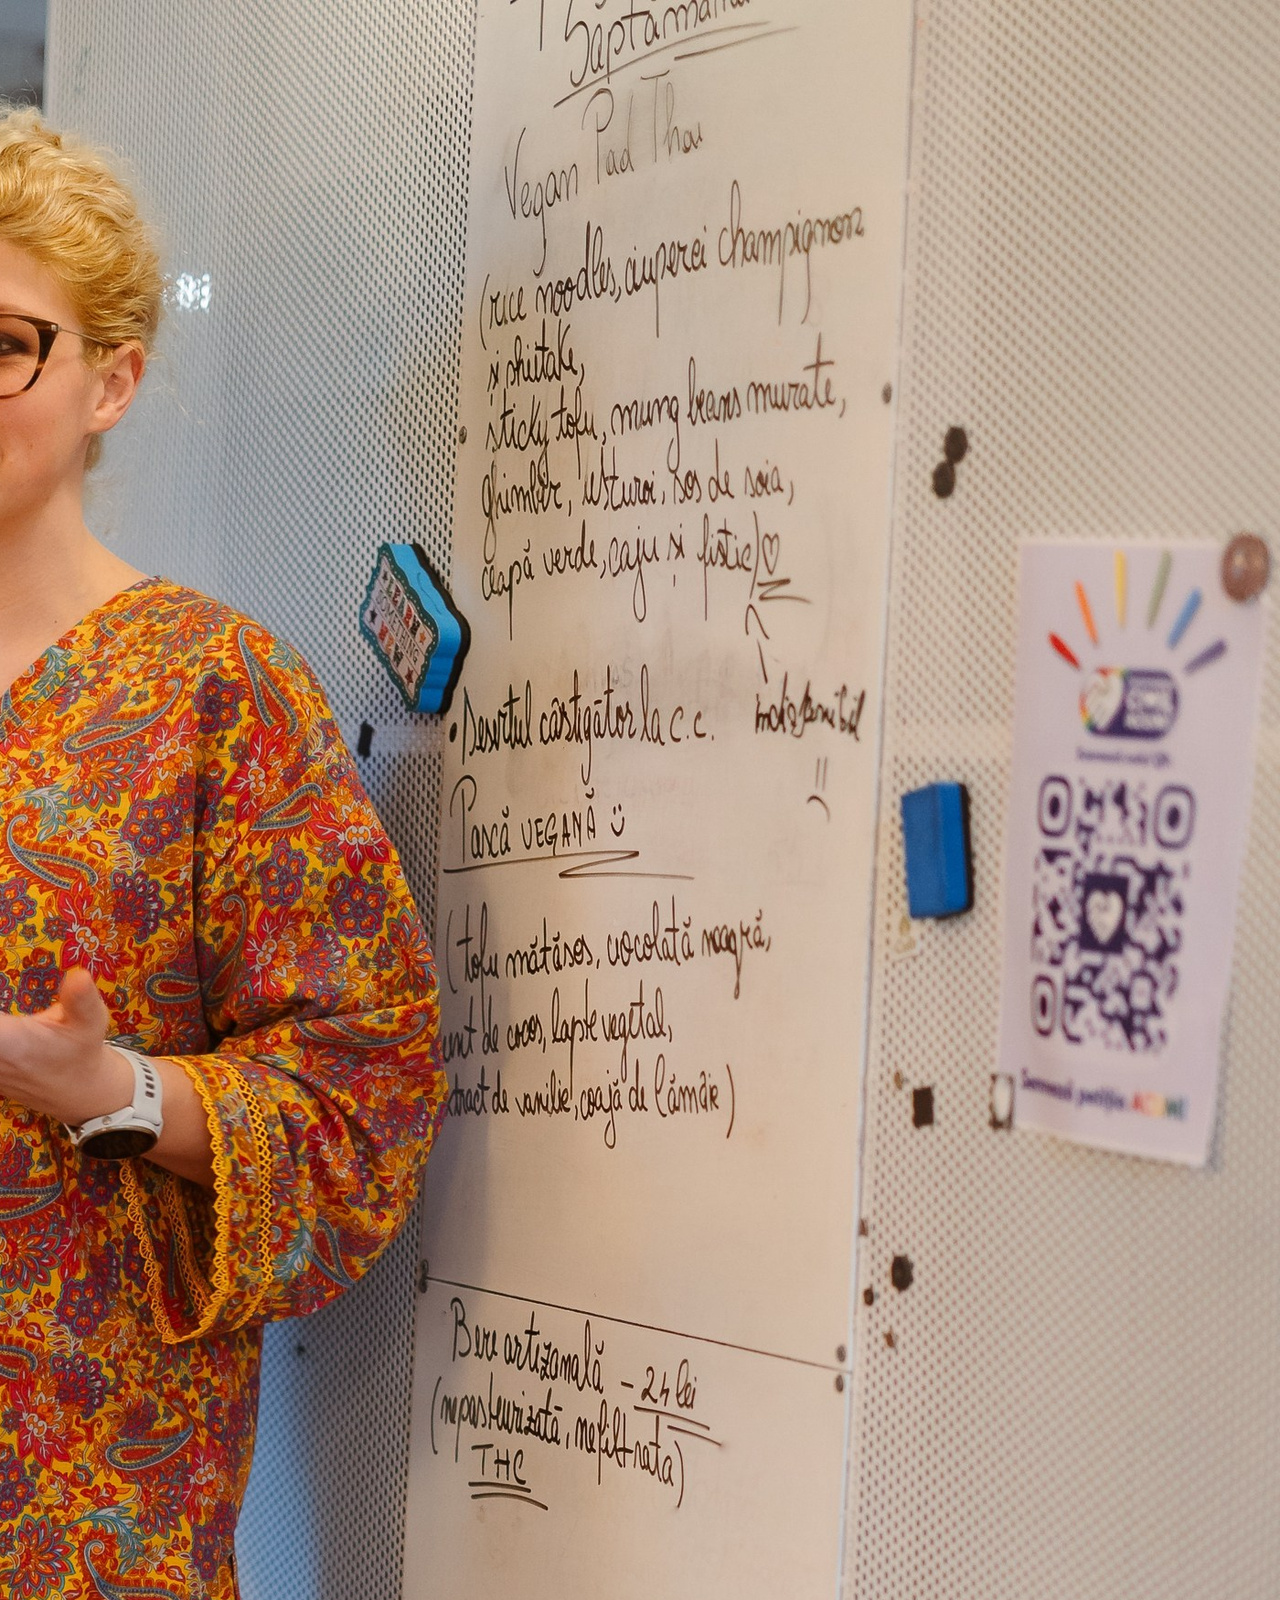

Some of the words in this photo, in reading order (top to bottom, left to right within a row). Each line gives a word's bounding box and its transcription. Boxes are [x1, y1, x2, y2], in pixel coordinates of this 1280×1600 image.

[505, 127, 579, 276] Vegan
[581, 87, 635, 185] Pad
[640, 70, 703, 163] Thai
[718, 179, 865, 326] champignon
[485, 387, 550, 488] sticky
[610, 394, 681, 474] mung
[686, 355, 742, 427] beans
[674, 469, 702, 504] sos
[708, 437, 735, 502] de
[482, 538, 535, 641] ceapă
[608, 525, 660, 623] caju
[640, 663, 666, 747] la
[450, 774, 511, 864] Pască
[483, 994, 499, 1055] de
[551, 978, 598, 1101] lapte
[492, 1068, 510, 1115] de
[628, 1058, 649, 1113] de
[450, 1297, 498, 1362] Bere
[503, 1311, 604, 1395] artizanală
[675, 1358, 698, 1410] lei
[471, 1443, 527, 1486] THC
